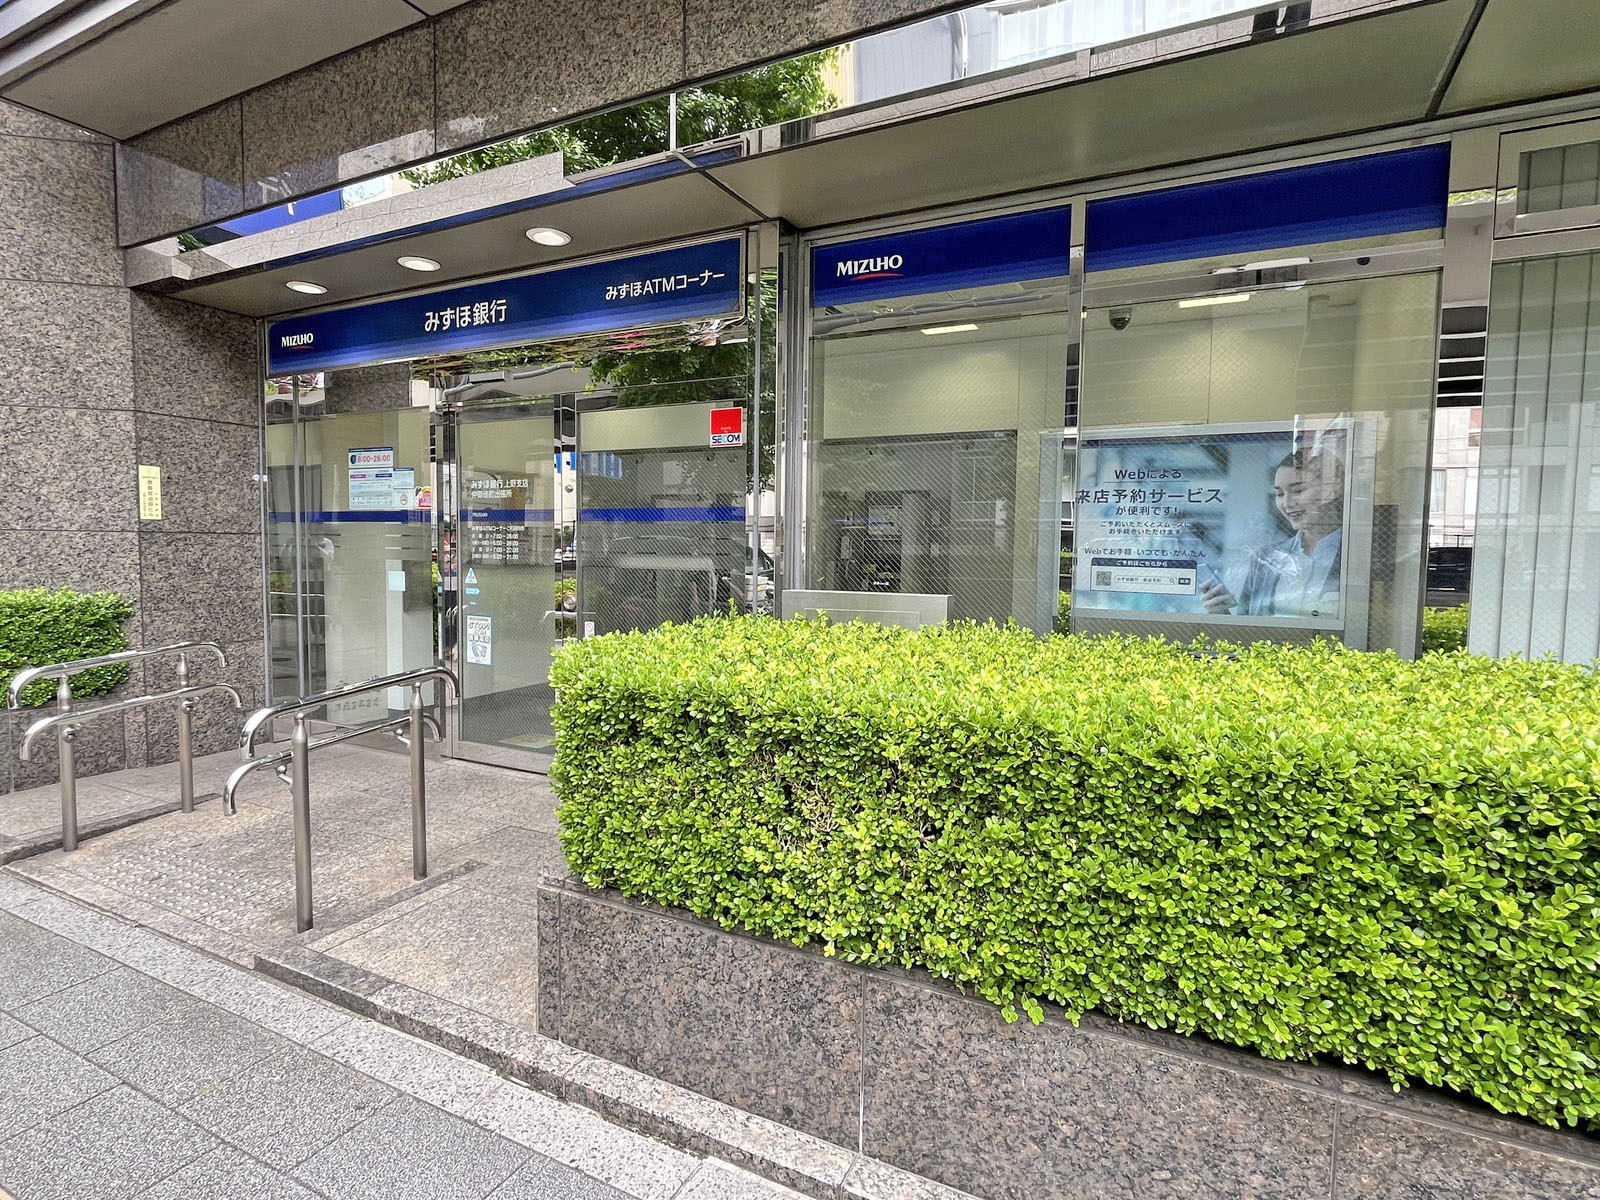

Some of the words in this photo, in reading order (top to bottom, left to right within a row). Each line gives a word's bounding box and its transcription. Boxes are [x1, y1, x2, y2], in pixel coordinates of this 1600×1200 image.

[836, 254, 903, 277] MIZUHO
[605, 269, 725, 300] みずほATMコーナー
[424, 299, 507, 332] みずほ銀行
[281, 332, 314, 347] MIZUHO
[711, 434, 741, 444] SECOM
[1114, 468, 1182, 480] Webによる
[1075, 488, 1223, 504] 来店予約サービス
[1115, 505, 1178, 516] が便利です!
